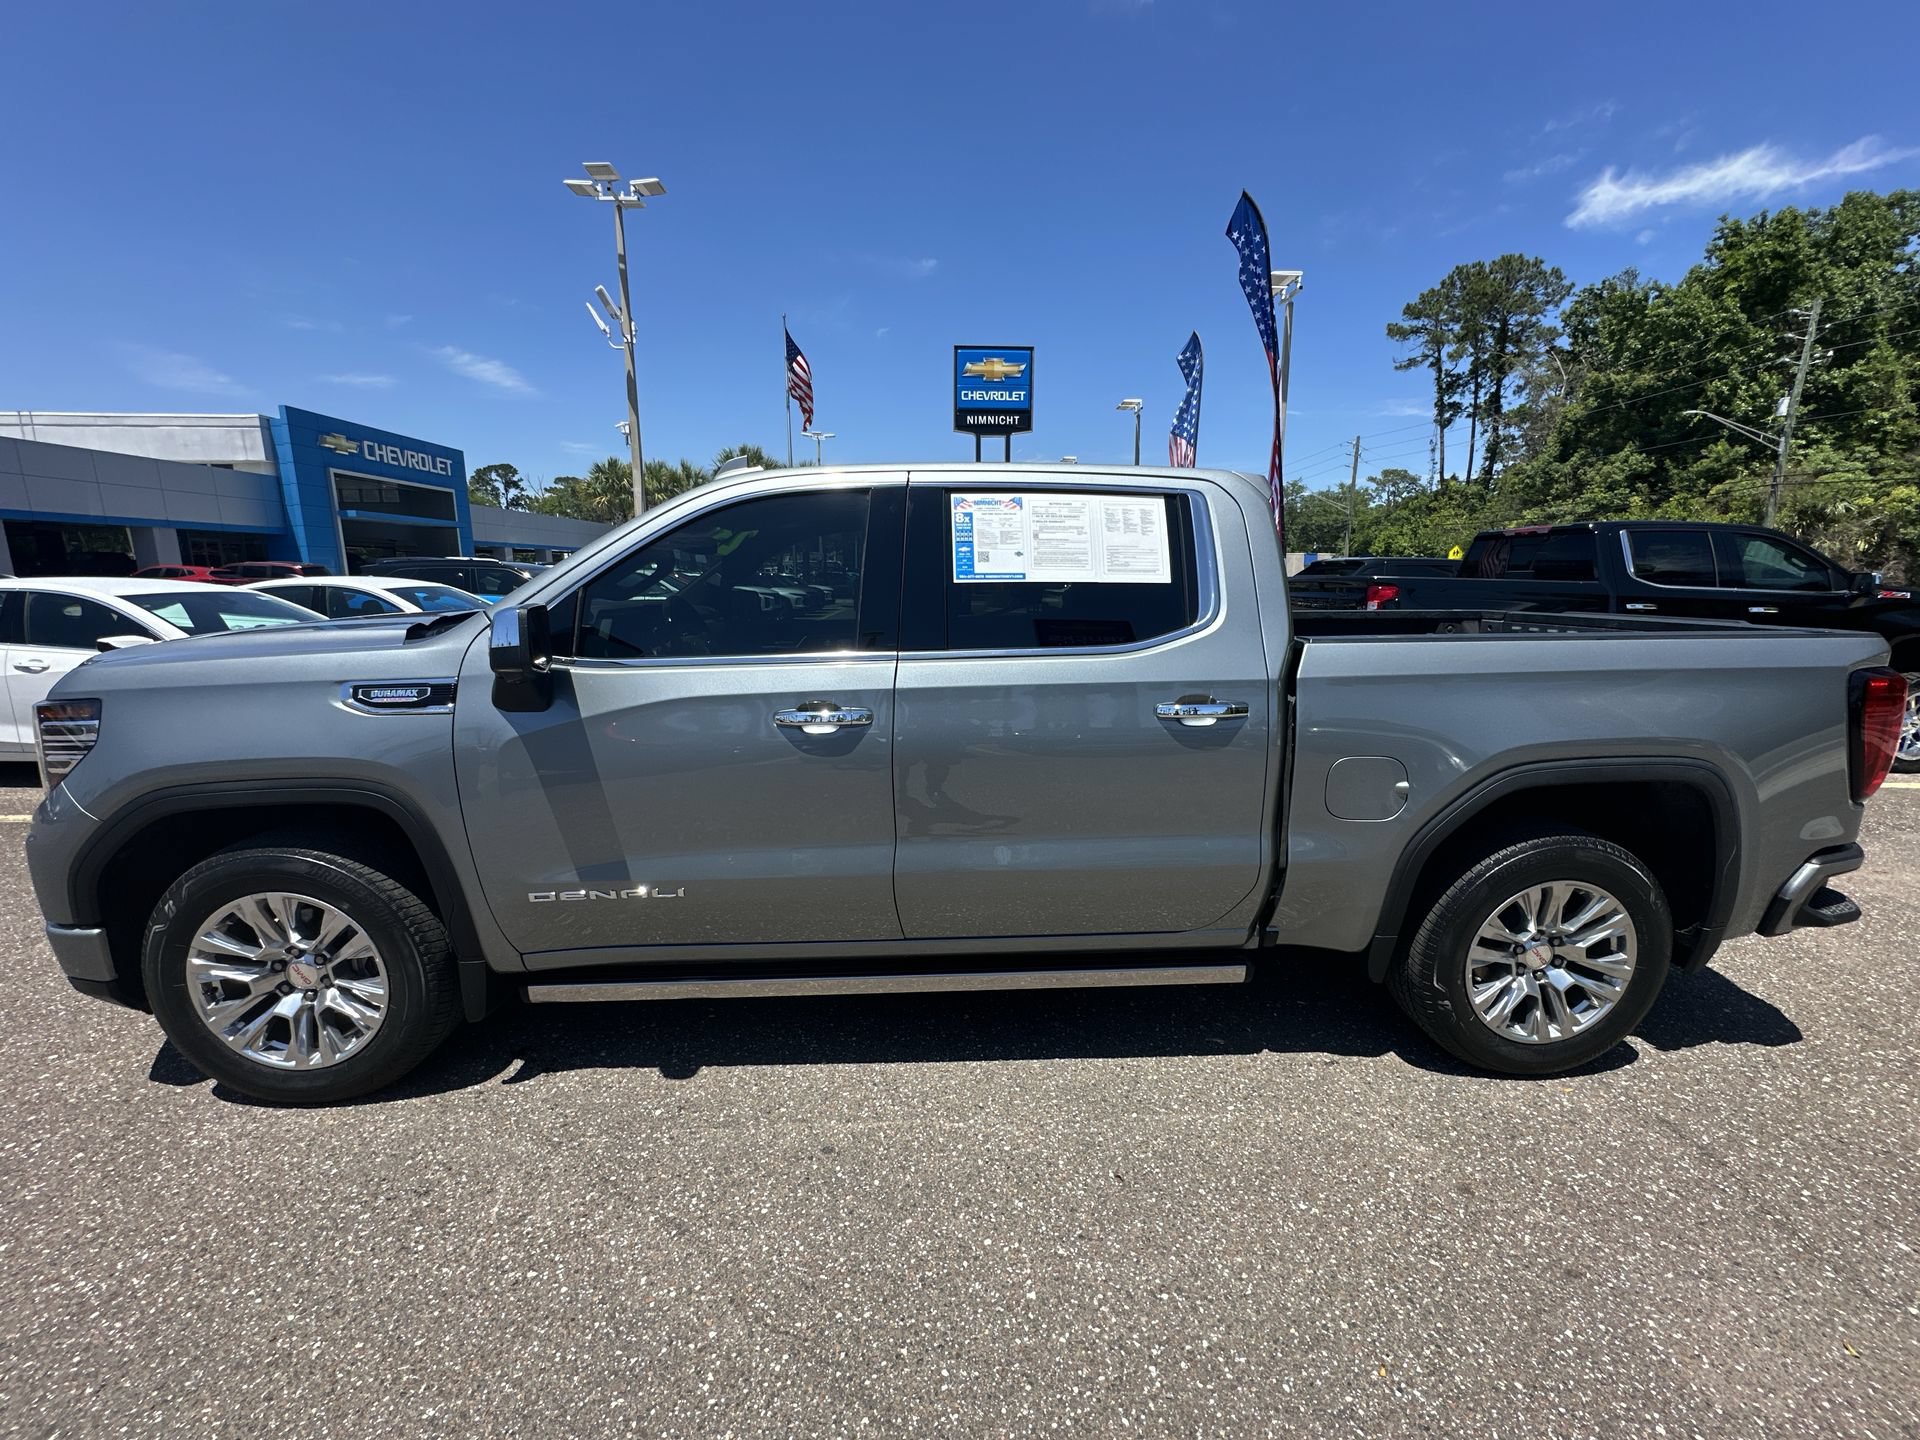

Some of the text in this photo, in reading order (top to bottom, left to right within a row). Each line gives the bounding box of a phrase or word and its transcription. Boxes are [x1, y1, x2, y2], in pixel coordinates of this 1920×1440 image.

[961, 390, 1026, 401] CHEVROLET
[966, 415, 1020, 425] NIMNICHT
[363, 440, 452, 476] CHEVROLET
[371, 689, 418, 698] DURAMAX
[527, 886, 685, 903] DENALI
[1531, 946, 1547, 965] GMC
[292, 963, 312, 985] GMC
